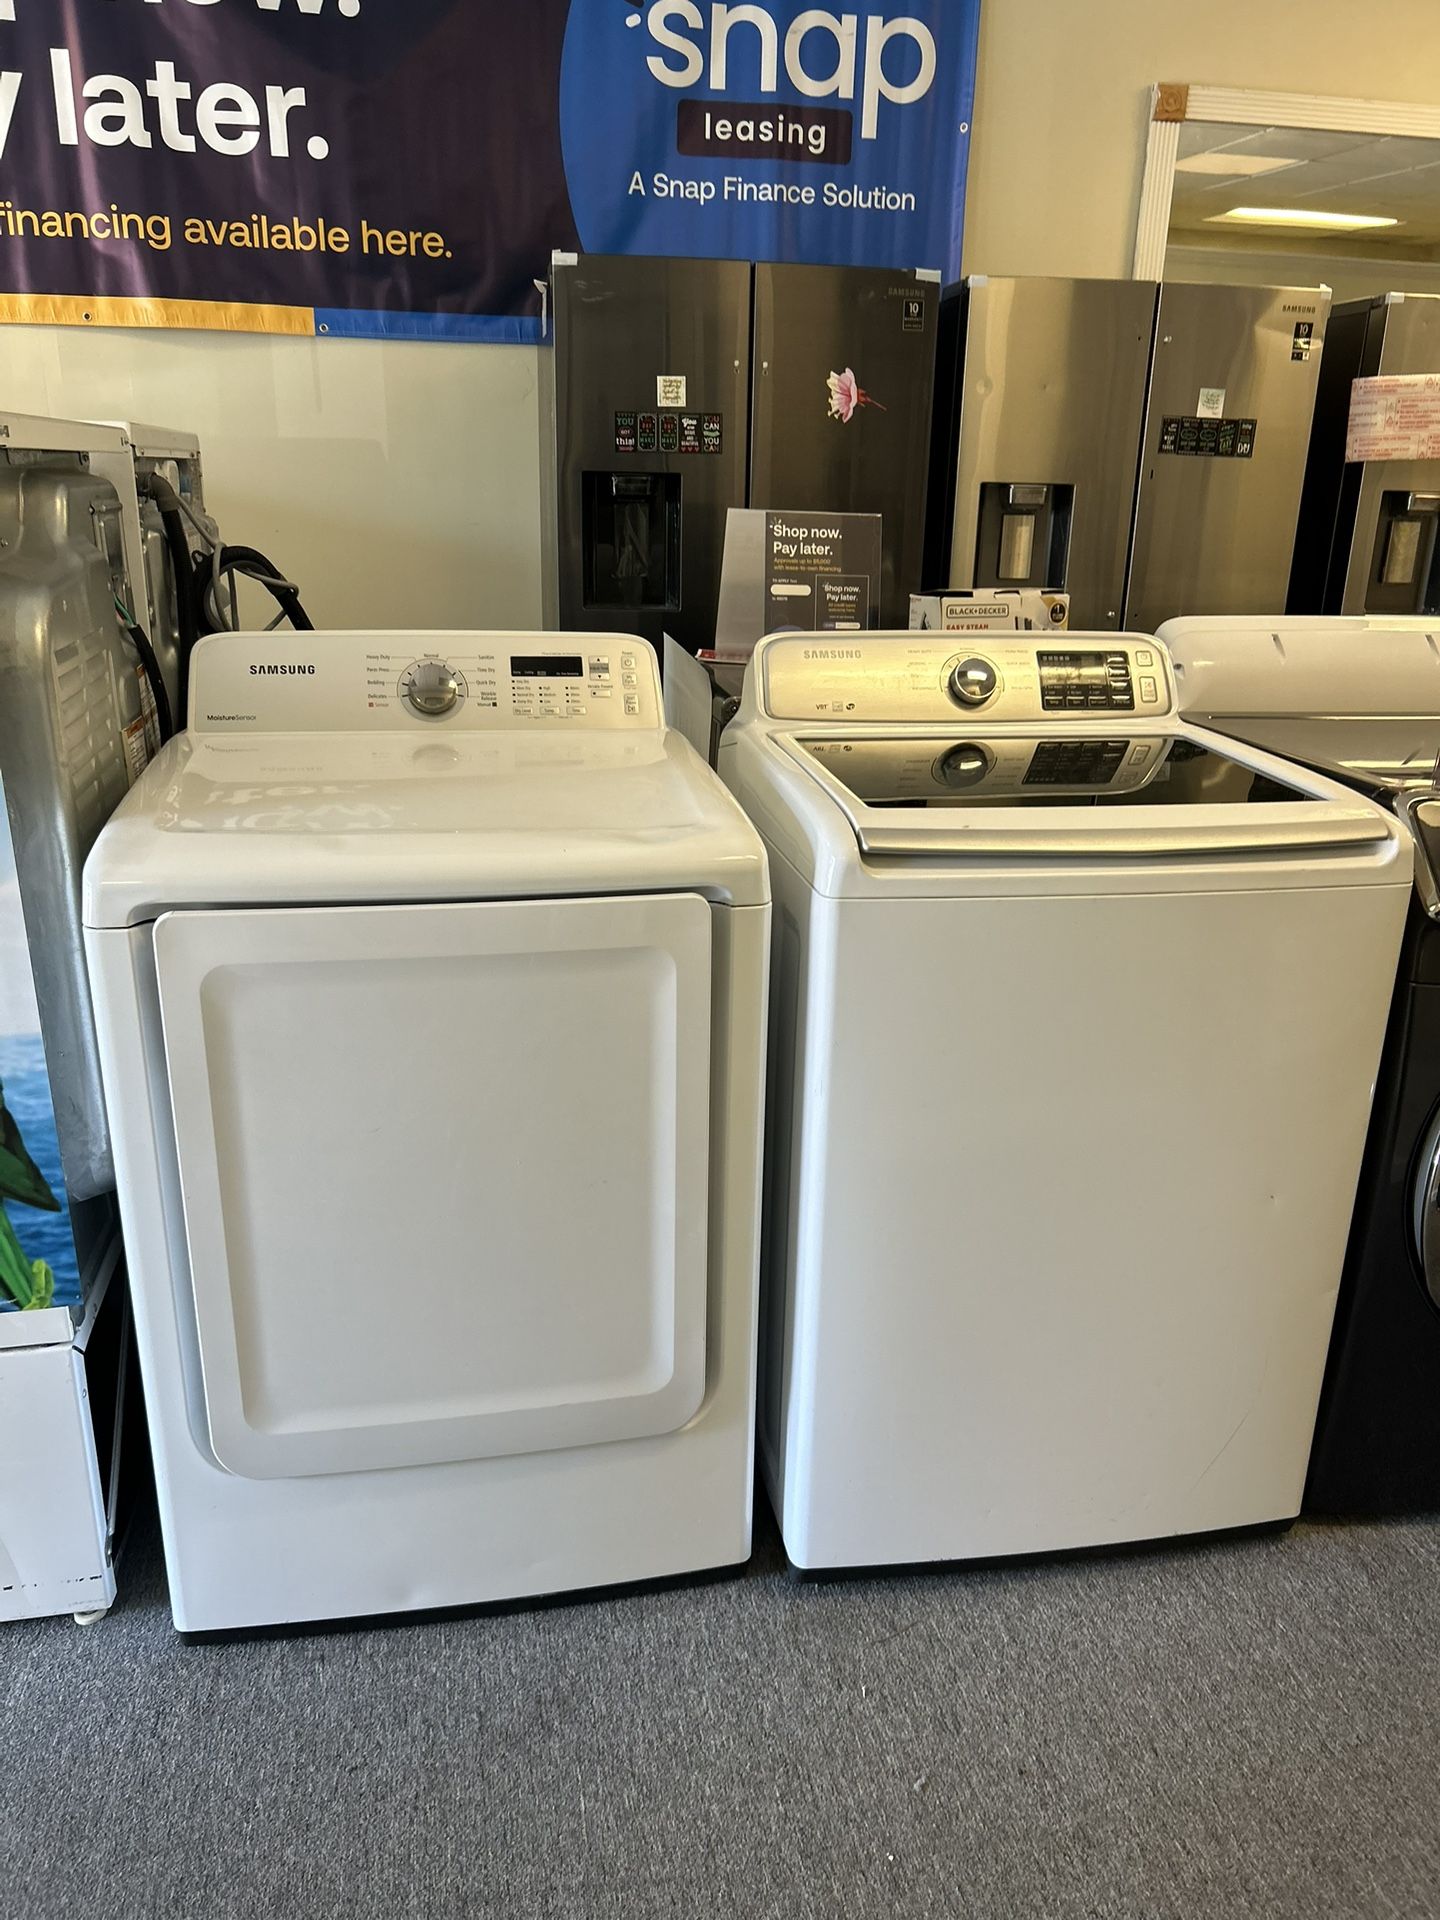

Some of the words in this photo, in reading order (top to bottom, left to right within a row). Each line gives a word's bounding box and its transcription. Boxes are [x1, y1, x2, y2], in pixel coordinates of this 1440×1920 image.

[647, 0, 936, 139] snap
[50, 48, 330, 160] later.
[705, 112, 827, 155] leasing
[628, 171, 645, 196] A
[653, 172, 716, 205] Snap
[724, 177, 815, 204] Finance
[823, 182, 916, 211] Solution
[184, 214, 350, 254] available
[361, 220, 453, 258] here.
[909, 302, 919, 313] 10
[1282, 305, 1316, 313] SAMSUNG
[703, 437, 720, 445] YOU
[773, 524, 809, 540] Shop
[811, 528, 843, 539] now.
[773, 541, 797, 557] Pay
[800, 542, 833, 555] later.
[824, 583, 843, 593] Shop
[826, 594, 840, 602] Pay
[804, 650, 861, 659] SAMSUNG
[250, 665, 315, 675] SAMSUNG
